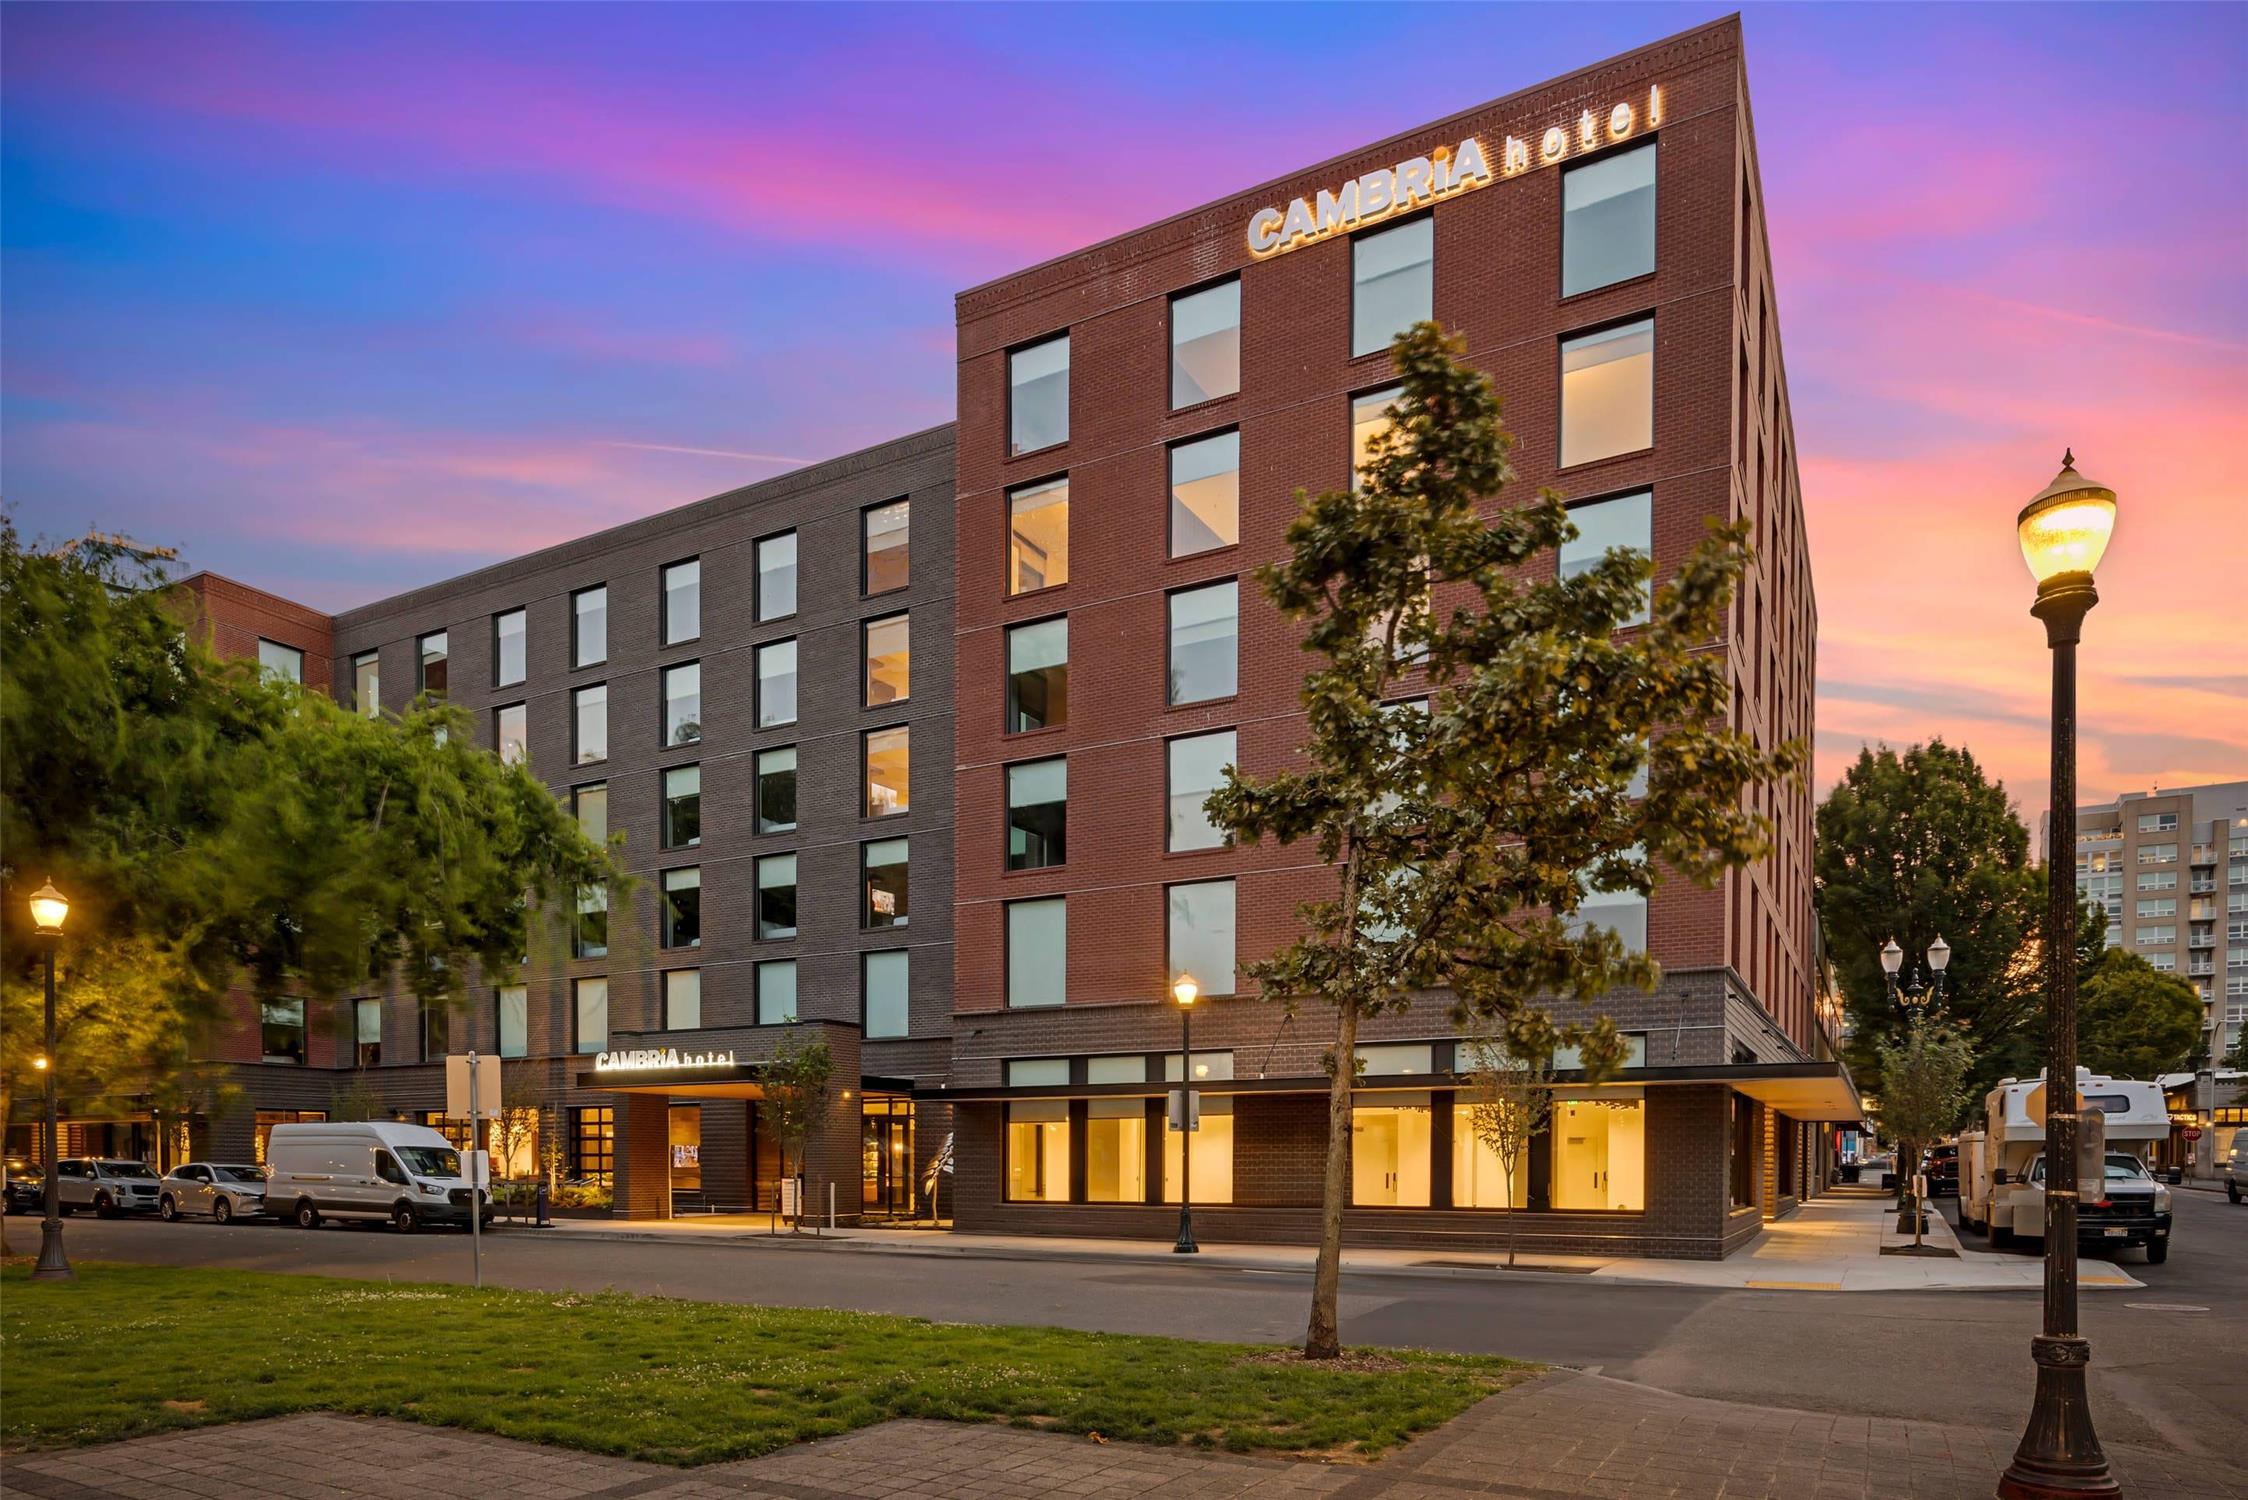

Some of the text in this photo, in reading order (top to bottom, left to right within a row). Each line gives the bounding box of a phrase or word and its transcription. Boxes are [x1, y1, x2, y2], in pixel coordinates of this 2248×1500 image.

[1505, 84, 1658, 172] hotel
[684, 1051, 733, 1066] hotel
[2173, 1113, 2197, 1121] TACTICS
